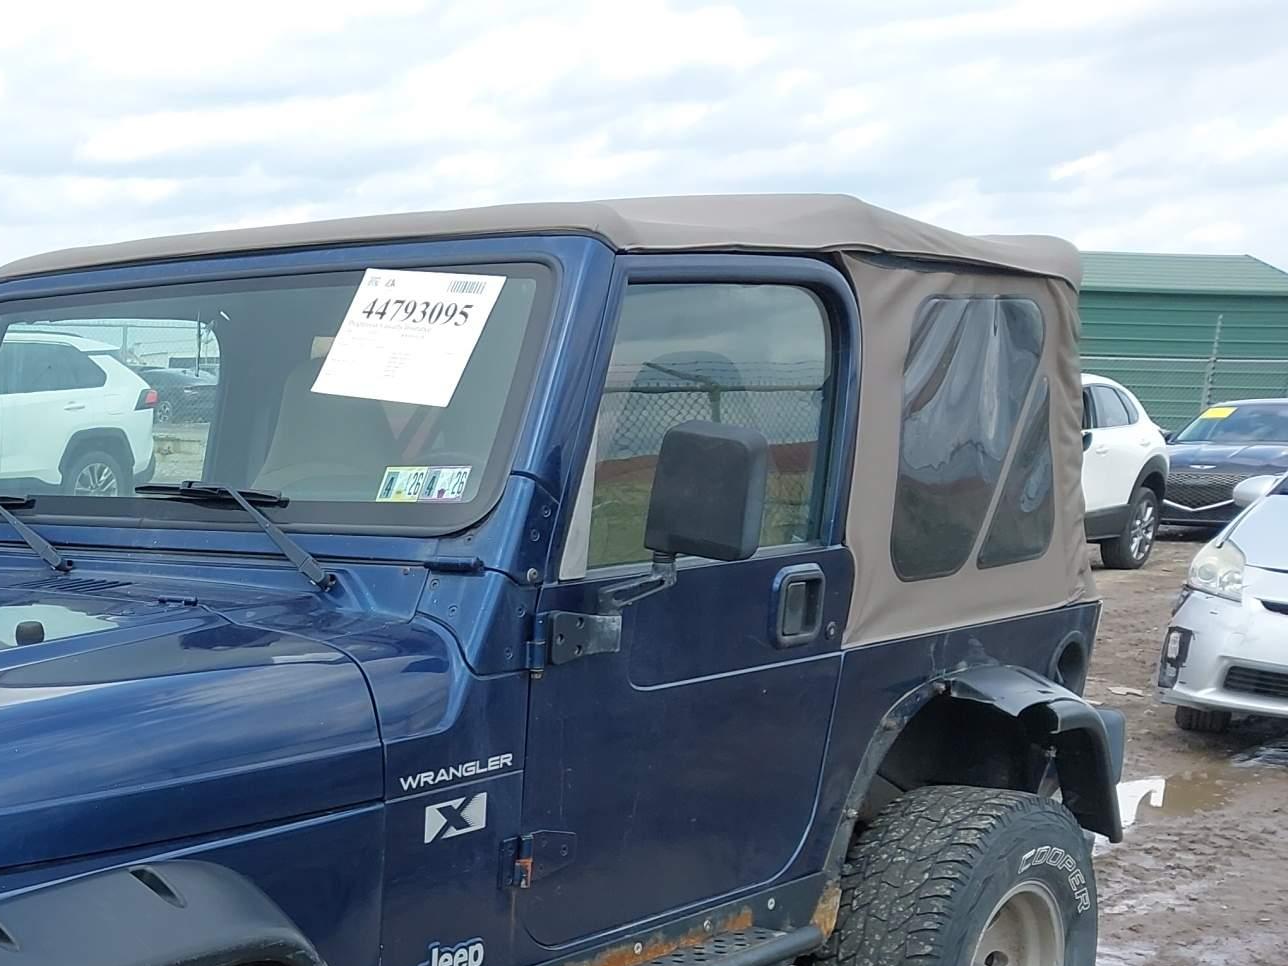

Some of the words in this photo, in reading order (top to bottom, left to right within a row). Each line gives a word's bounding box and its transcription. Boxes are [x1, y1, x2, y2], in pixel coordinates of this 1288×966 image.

[362, 297, 474, 327] 44793095
[383, 476, 395, 497] 4
[407, 471, 424, 496] 26
[424, 475, 436, 497] 4
[451, 471, 468, 495] 26
[399, 753, 513, 792] WRANGLER
[425, 792, 487, 844] X
[1017, 845, 1091, 914] COOPER
